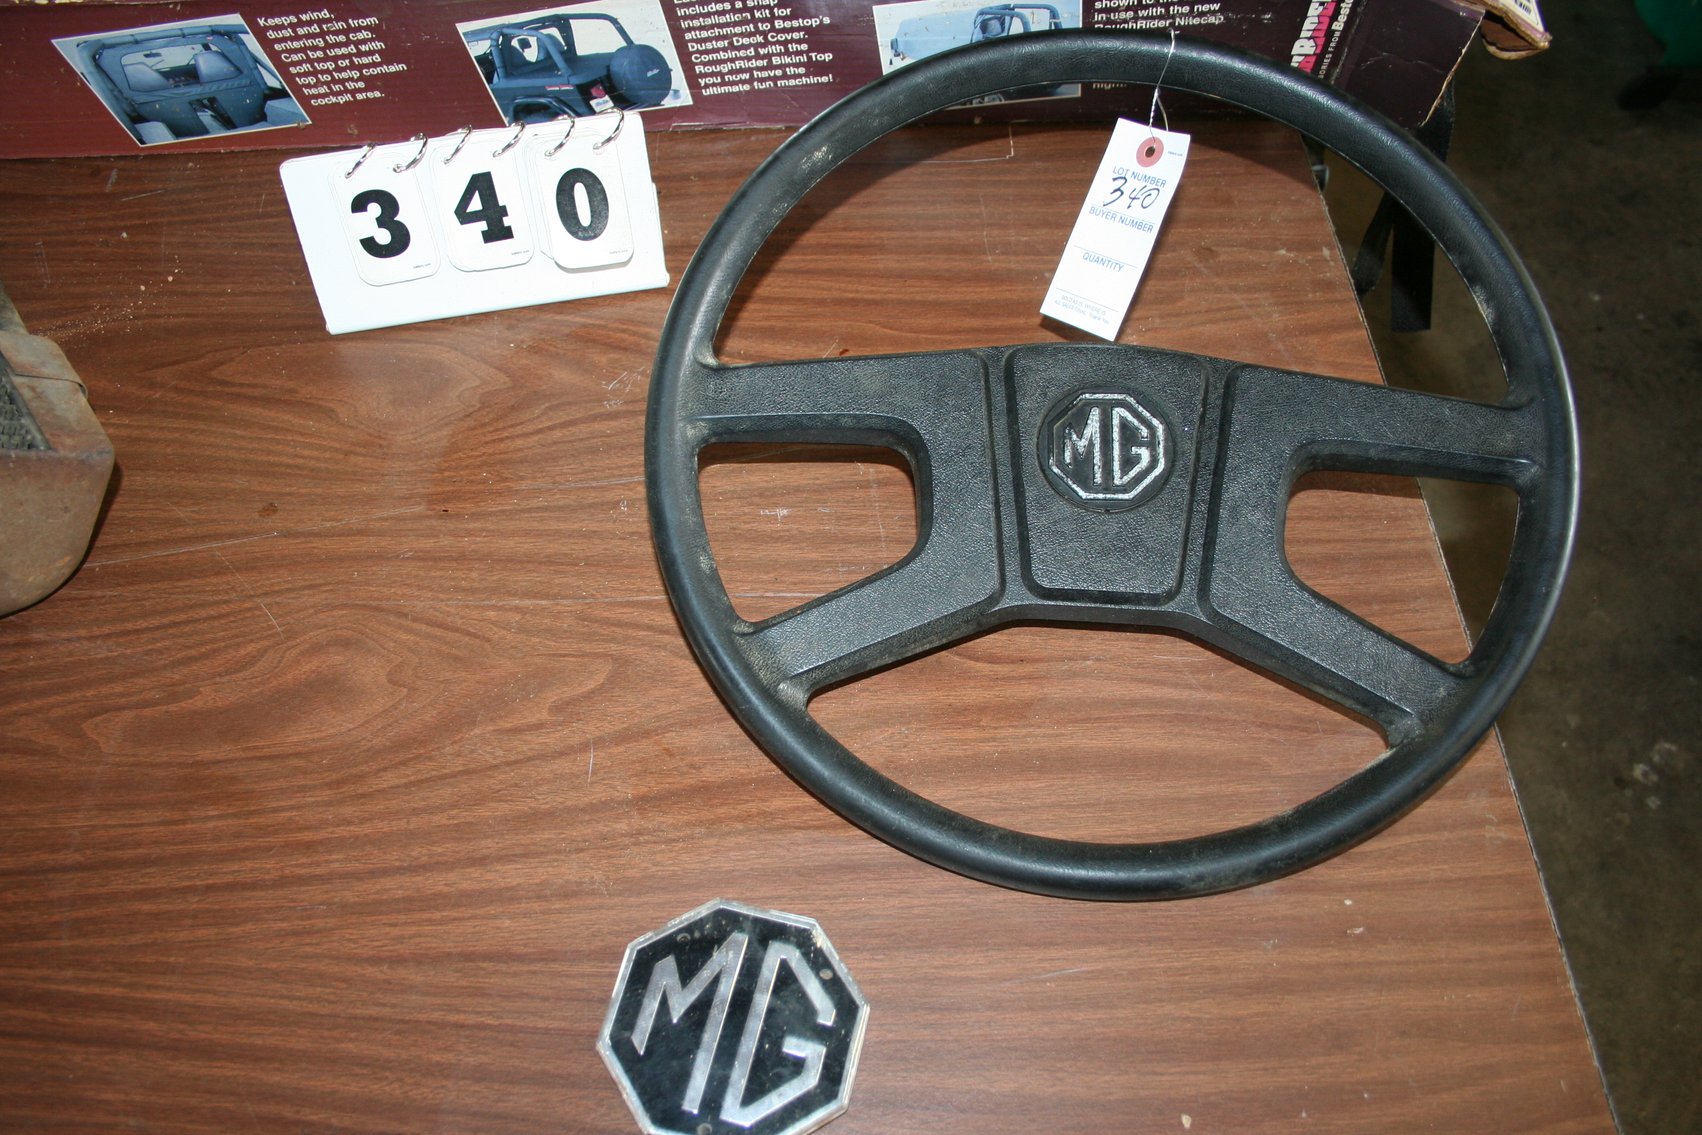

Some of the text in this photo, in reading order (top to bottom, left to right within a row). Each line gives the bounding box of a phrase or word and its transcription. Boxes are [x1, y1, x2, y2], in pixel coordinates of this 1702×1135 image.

[257, 8, 334, 27] Keeps wind,
[676, 1, 731, 16] includes
[680, 6, 792, 29] installation kit for
[1094, 2, 1221, 20] in use with the new
[266, 16, 378, 39] dust and rain from
[684, 15, 831, 40] attachment to Bestop's
[274, 30, 376, 51] entering the cab.
[281, 40, 385, 62] Can be used with
[688, 30, 808, 52] Duster Deck Cover.
[1328, 31, 1341, 51] FROM
[692, 42, 808, 62] Combined with the
[694, 51, 833, 74] RoughRider Bikini Top
[289, 54, 381, 74] soft top or hard
[296, 62, 407, 86] top to help contain
[698, 66, 806, 87] you now have the
[702, 74, 833, 96] ultimate fun machine!
[302, 80, 365, 96] heat in the
[310, 90, 385, 106] cockpit area.
[1112, 165, 1166, 188] LOT NUMBER
[1103, 176, 1160, 210] 340
[1089, 206, 1154, 233] BUYER NUMBER
[1082, 252, 1124, 272] QUANTITY
[1064, 406, 1150, 486] MG
[631, 930, 836, 1128] MG
